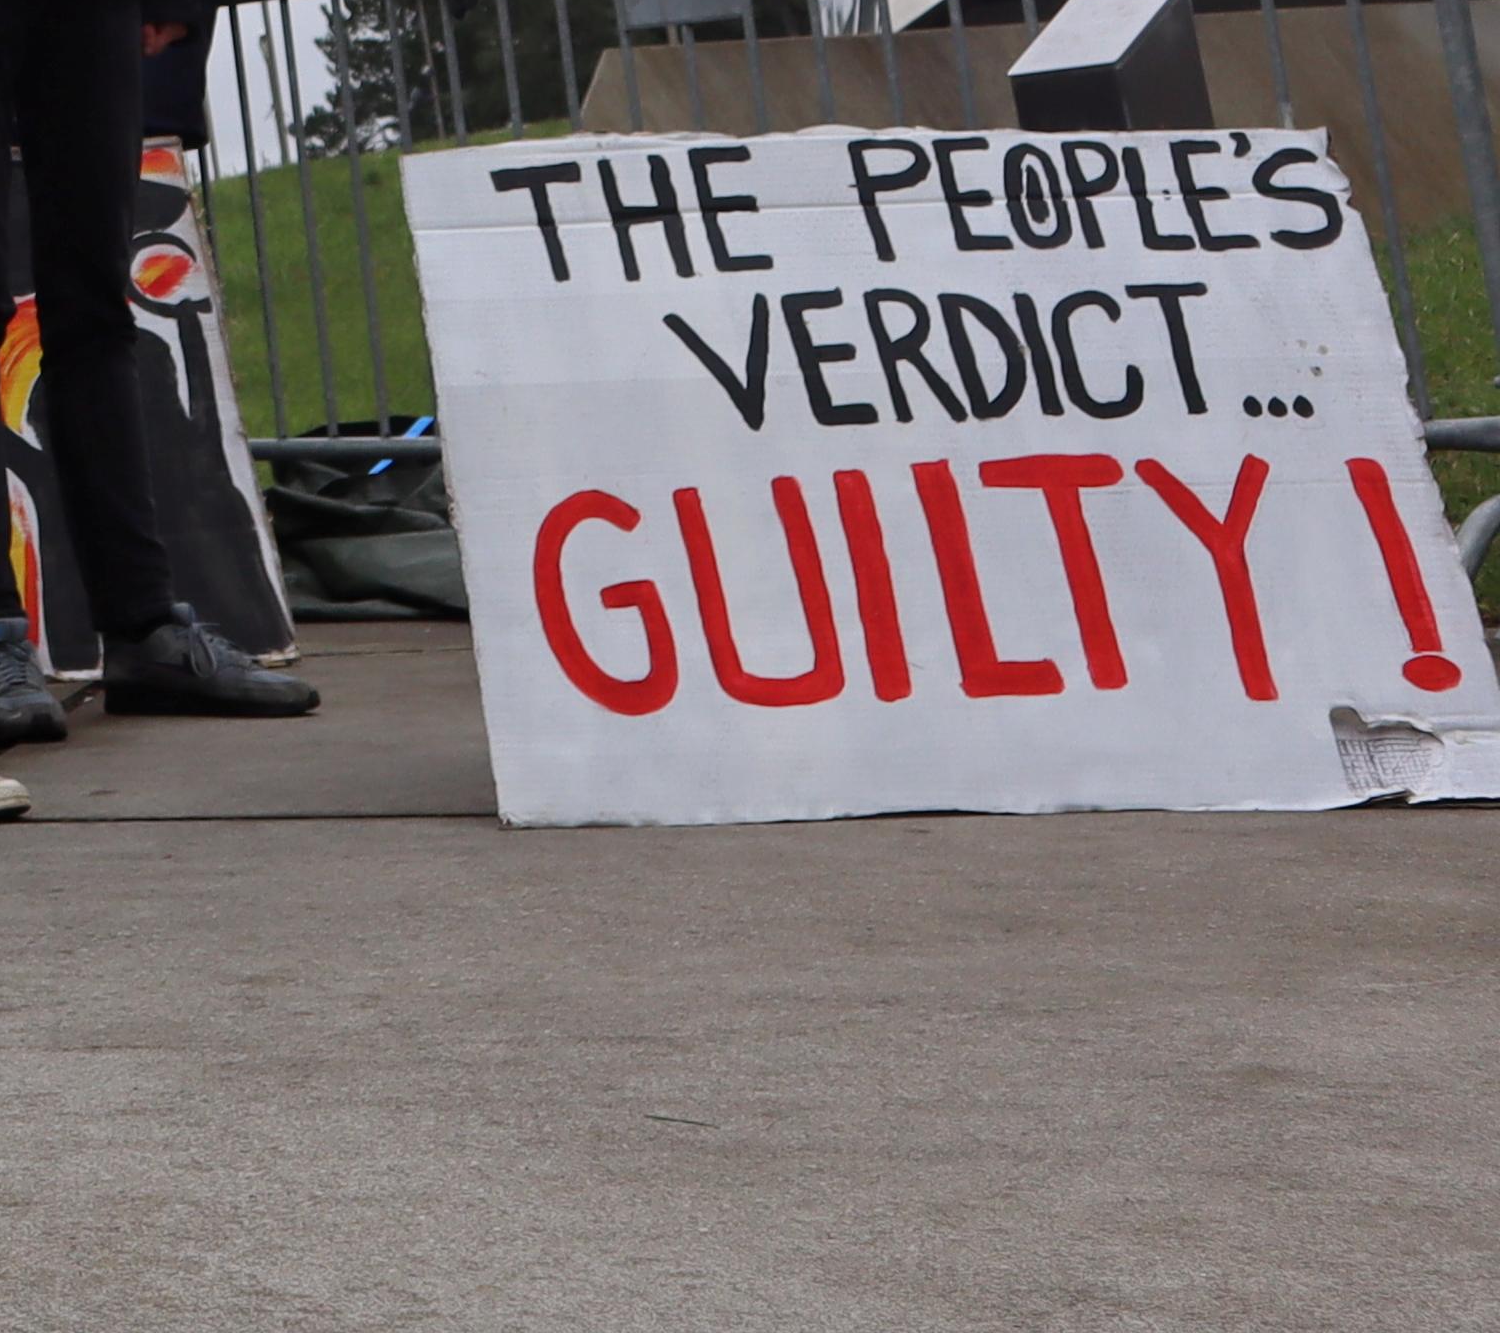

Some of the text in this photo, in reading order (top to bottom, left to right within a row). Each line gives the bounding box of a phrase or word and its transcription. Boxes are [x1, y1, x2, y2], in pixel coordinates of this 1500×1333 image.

[491, 131, 1344, 283] THE PEOPLE'S
[664, 282, 1315, 431] VERDICT...
